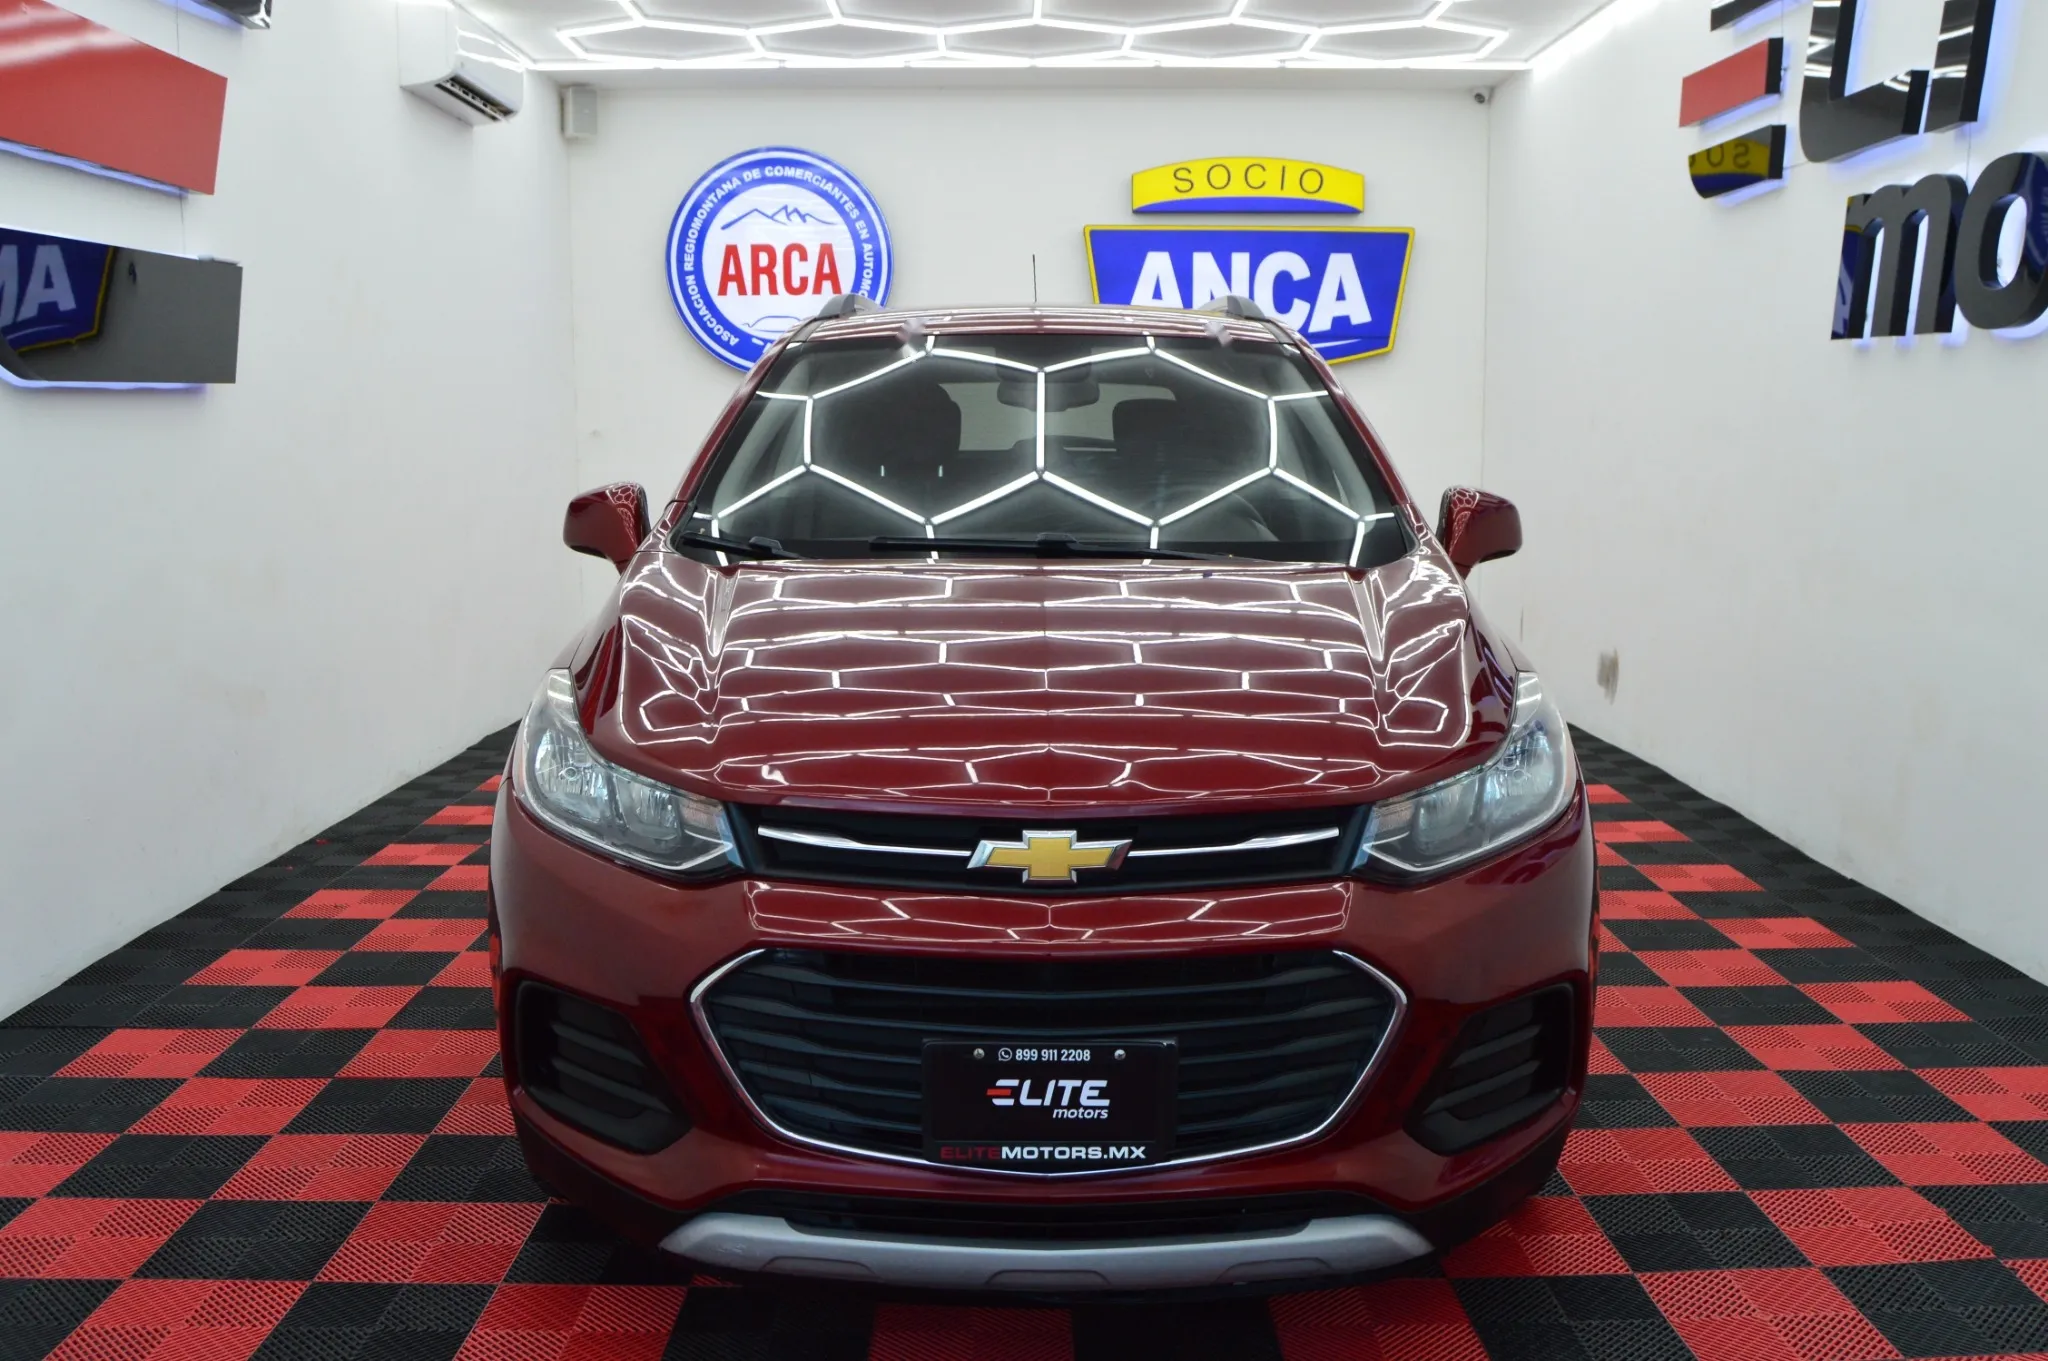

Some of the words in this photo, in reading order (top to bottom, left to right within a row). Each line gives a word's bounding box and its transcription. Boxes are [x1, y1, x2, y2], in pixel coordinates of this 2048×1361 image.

[742, 168, 762, 182] DE
[1172, 163, 1325, 195] SOCIO
[764, 166, 861, 221] COMERCIANTES
[683, 176, 742, 272] REGIOMONTANA
[855, 219, 871, 240] EN
[717, 242, 843, 297] ARCA
[1130, 250, 1373, 334] ANCA
[685, 274, 740, 347] ASOCIACION
[1015, 1048, 1038, 1062] 899
[1041, 1048, 1058, 1062] 911
[1060, 1048, 1091, 1062] 2208
[986, 1079, 1111, 1107] ELITE
[1052, 1107, 1109, 1119] motors
[939, 1146, 1147, 1160] ELITEMOTORS.MX
